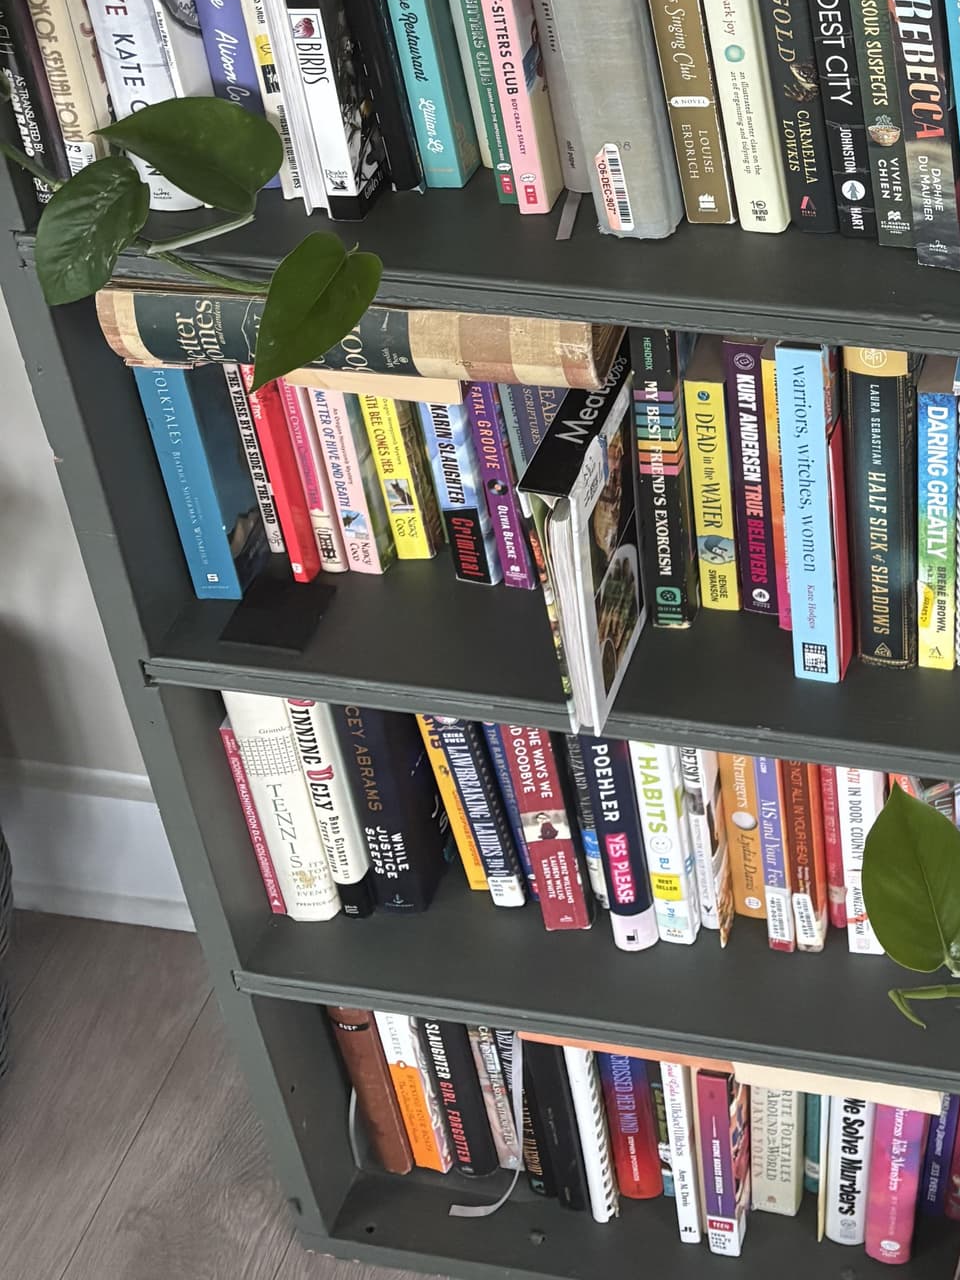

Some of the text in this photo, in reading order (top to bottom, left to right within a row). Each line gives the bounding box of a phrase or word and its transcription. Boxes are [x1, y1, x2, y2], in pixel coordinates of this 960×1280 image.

[825, 56, 852, 105] CITY
[682, 124, 699, 178] ERDRICH
[699, 130, 713, 173] LOUISE
[839, 125, 865, 231] JOHNSTON HART
[918, 155, 934, 221] DU MAURIER
[930, 168, 944, 212] DAPHNE
[478, 422, 499, 469] GROOVE
[695, 414, 716, 452] DEAD
[869, 384, 883, 465] LAURA SEBASTIAN
[430, 404, 465, 504] KARIN SLAUGHTER
[645, 382, 673, 577] MY BEST FRIEND'S EXORCISM
[704, 468, 715, 481] the
[737, 373, 768, 584] KURT ANDERSEN TRUE BELIEVERS
[701, 483, 724, 529] WATER
[868, 473, 886, 514] HALF
[926, 407, 949, 559] DARING GREATLY
[497, 505, 517, 560] OLIVIA BLACKE
[870, 518, 888, 550] SICK
[871, 566, 889, 636] SHADOWS
[592, 744, 619, 822] POEHLER
[365, 827, 386, 875] SLEEPS
[376, 827, 398, 879] JUSTICE
[392, 832, 410, 872] WHILE
[608, 836, 634, 904] YES PLEASE
[426, 1024, 450, 1079] SLAUGHTER
[448, 1110, 471, 1163] FORGOTTEN
[842, 1117, 864, 1155] Solve
[839, 1157, 862, 1216] Murders
